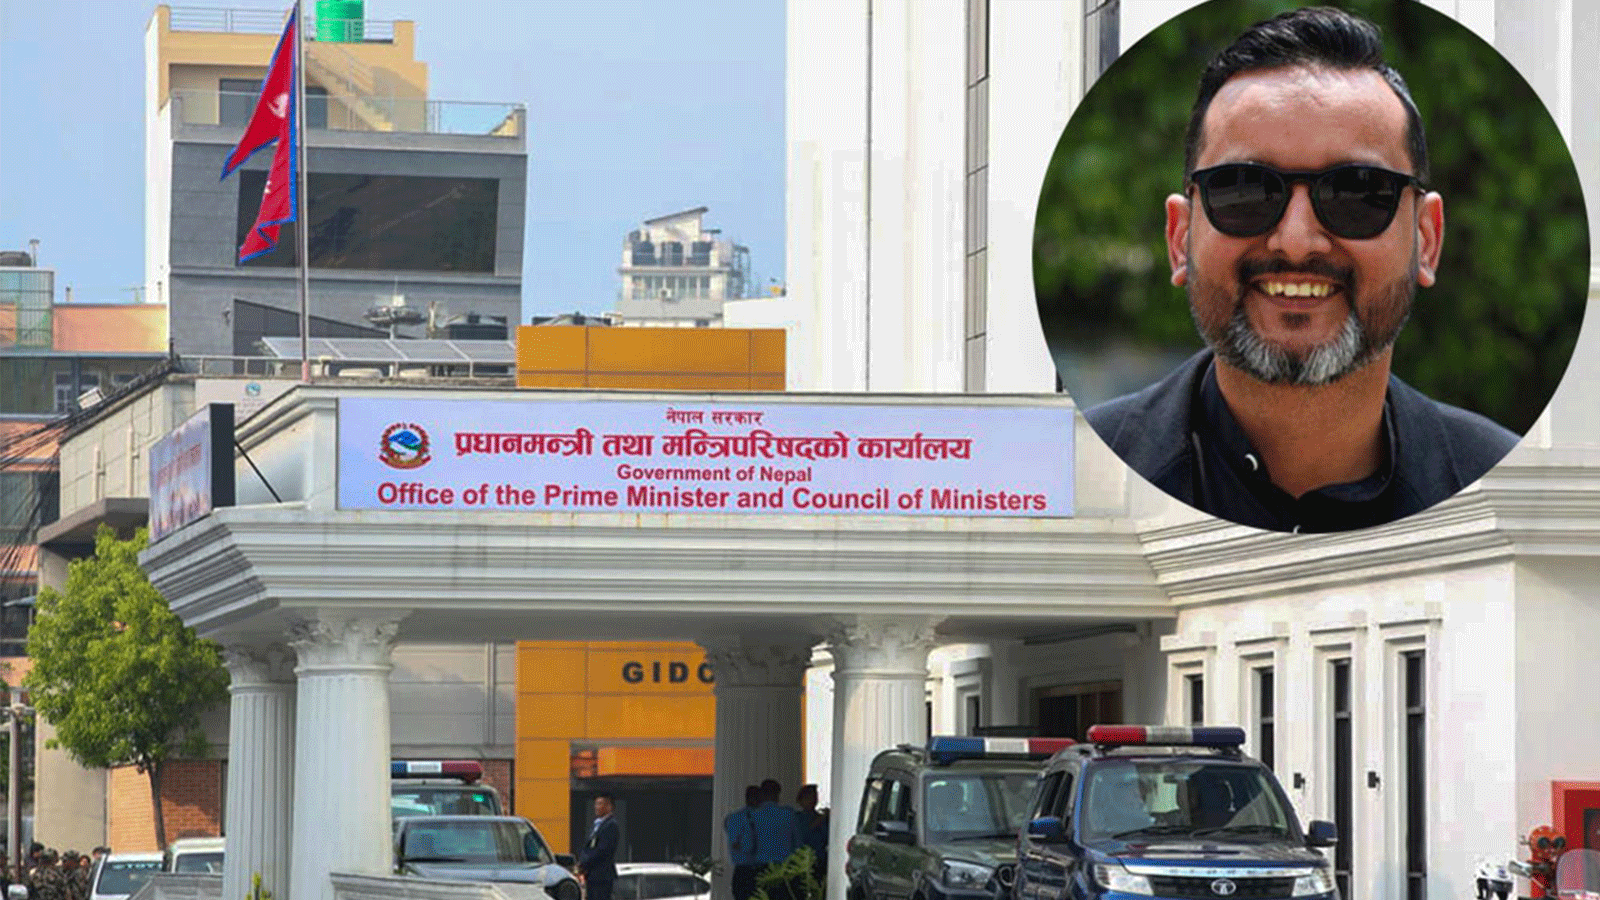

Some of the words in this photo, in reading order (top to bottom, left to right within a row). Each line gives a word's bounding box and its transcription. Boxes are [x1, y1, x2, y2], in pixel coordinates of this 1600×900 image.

[665, 407, 705, 424] नेपाल
[711, 411, 763, 426] सरकार
[454, 427, 594, 456] प्रधानमन्त्री
[603, 433, 655, 457] तथा
[857, 432, 972, 460] कार्यालय
[617, 464, 731, 481] Government
[736, 465, 755, 481] of
[759, 466, 812, 485] Nepal
[377, 482, 455, 505] Office
[462, 483, 489, 506] of
[495, 485, 535, 507] the
[543, 484, 618, 507] Prime
[626, 485, 731, 509] Minister
[736, 486, 784, 509] and
[791, 486, 890, 510] Council
[897, 488, 924, 510] of
[930, 487, 1047, 512] Ministers
